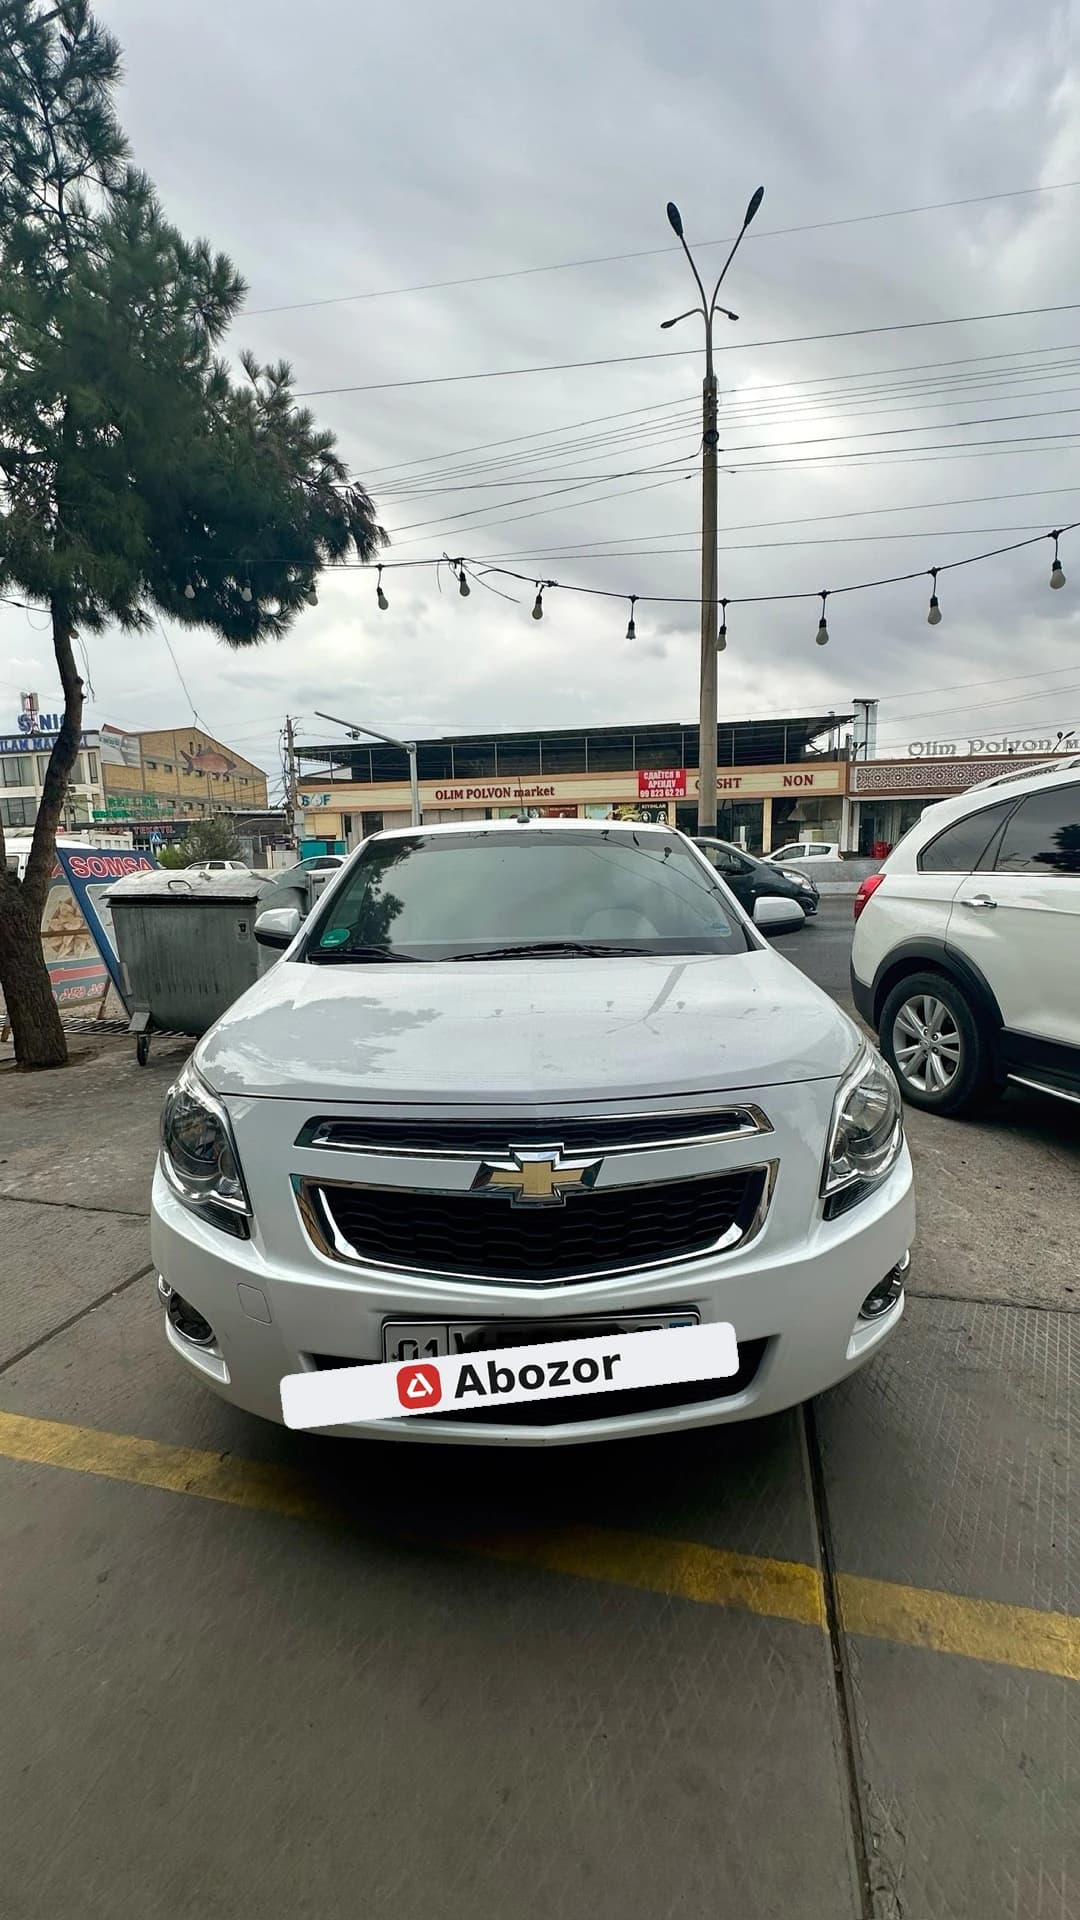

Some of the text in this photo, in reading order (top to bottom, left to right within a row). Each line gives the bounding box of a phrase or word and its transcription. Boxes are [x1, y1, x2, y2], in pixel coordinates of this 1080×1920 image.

[908, 741, 957, 756] Olim
[783, 774, 814, 787] NON
[435, 786, 555, 800] OLIM POLVON market
[69, 856, 154, 878] SOMSA
